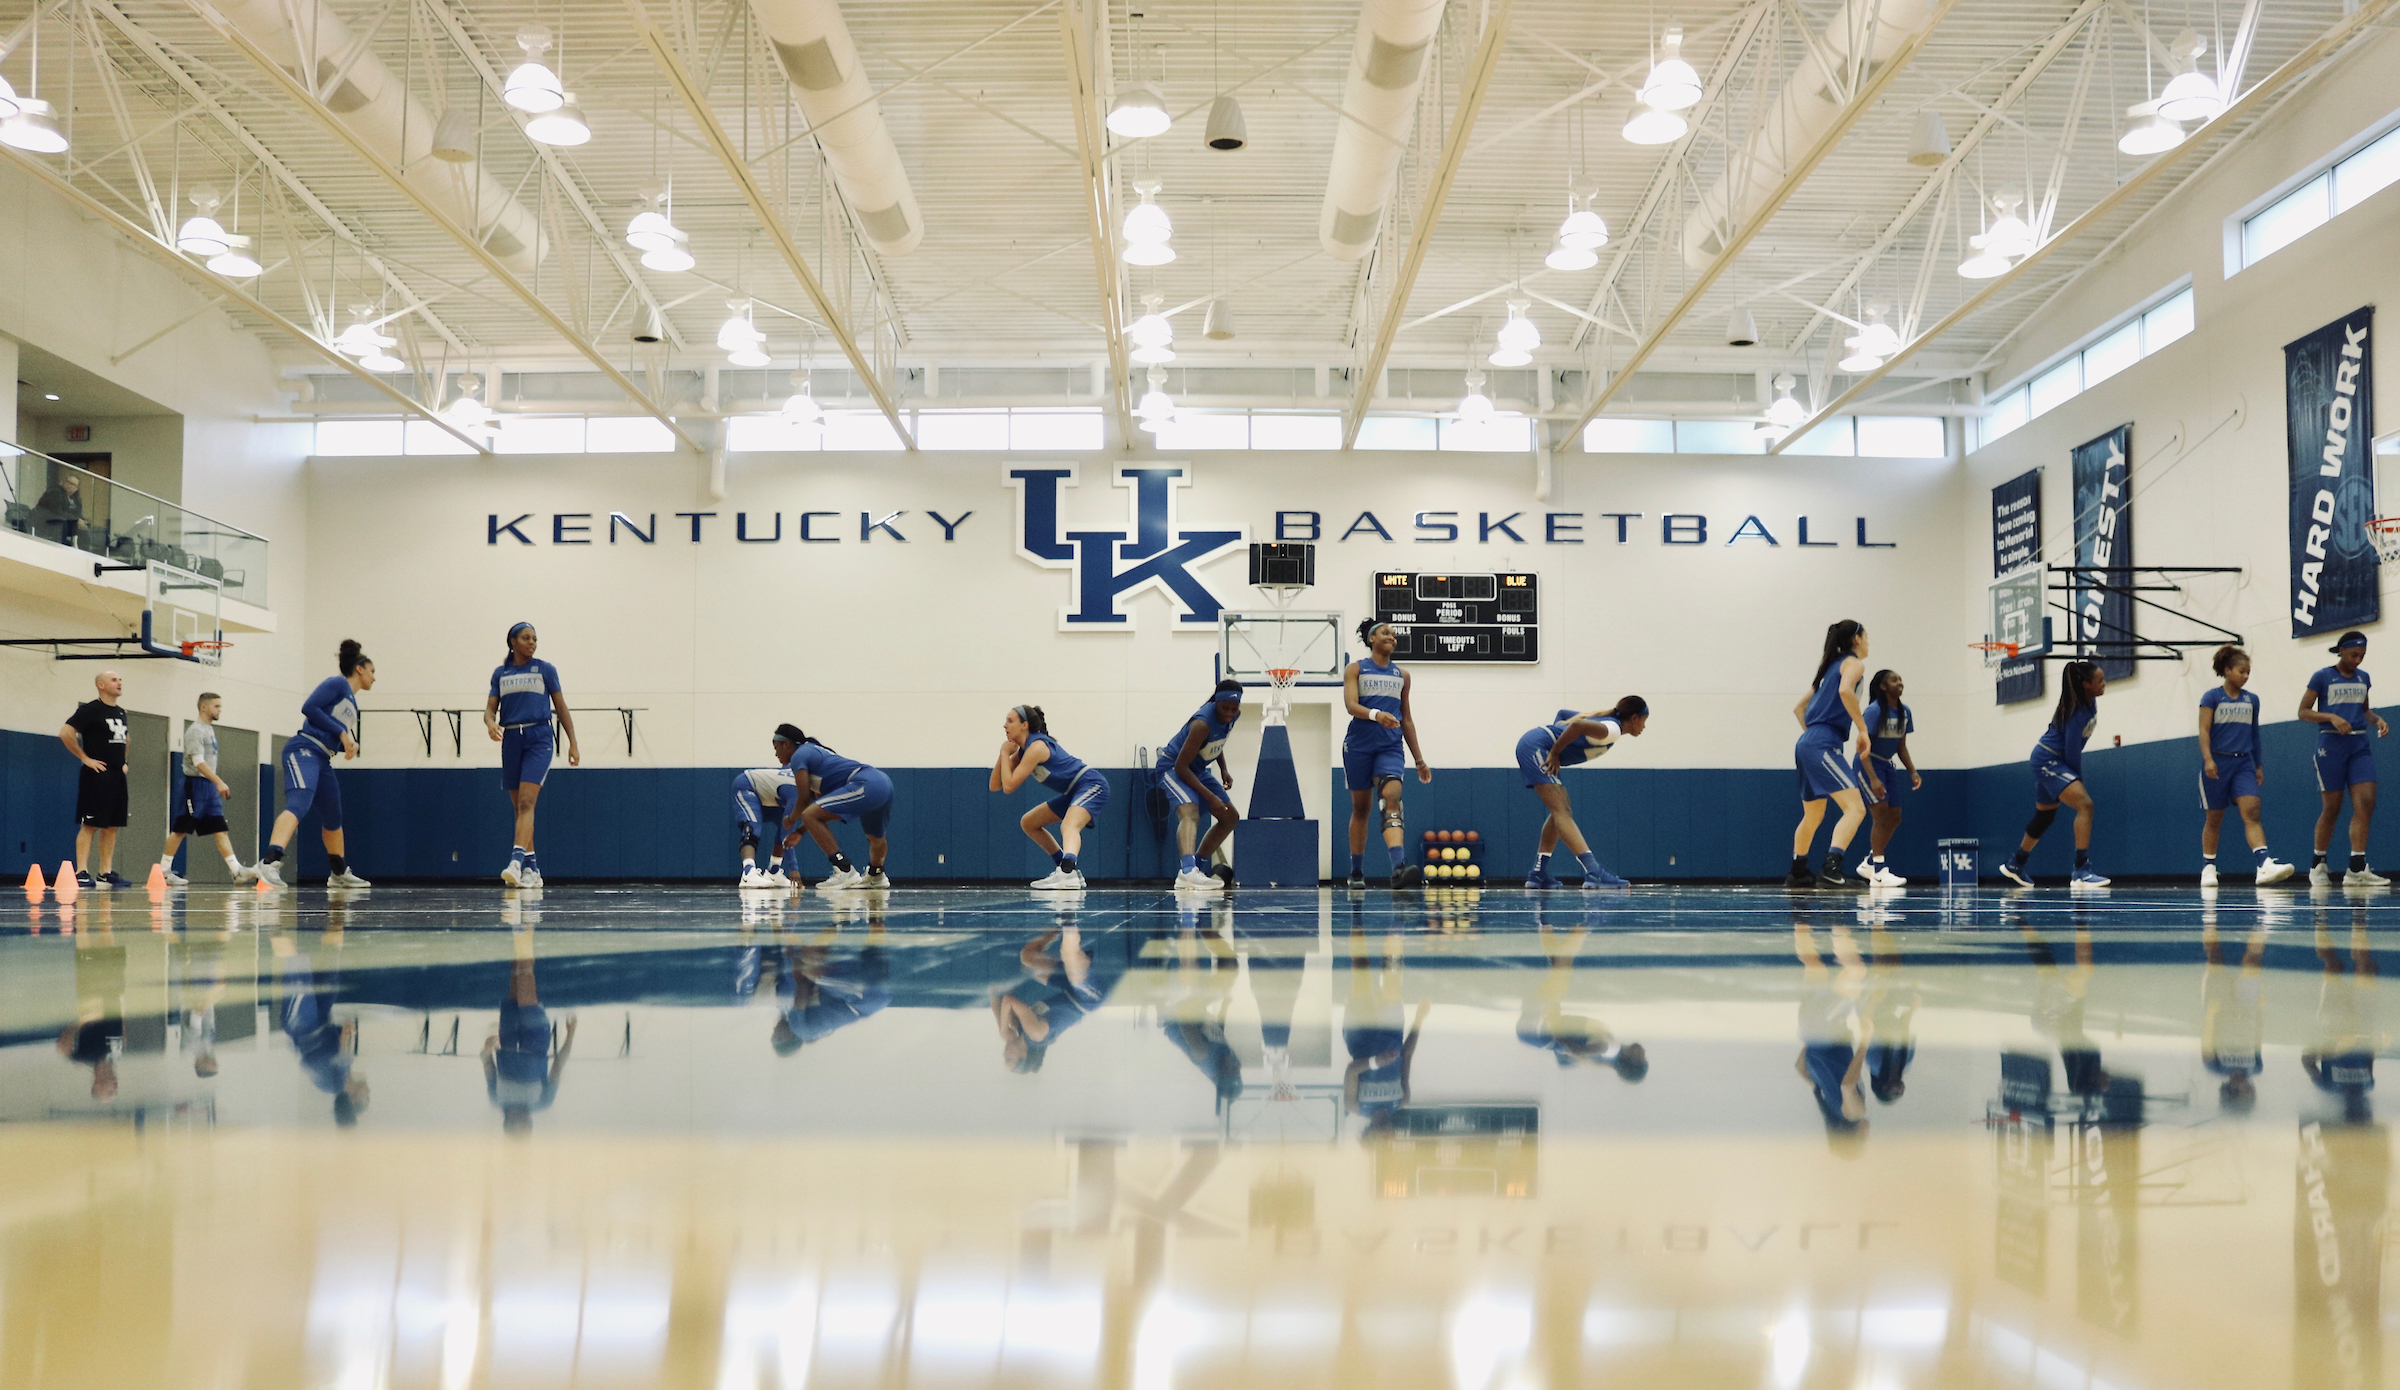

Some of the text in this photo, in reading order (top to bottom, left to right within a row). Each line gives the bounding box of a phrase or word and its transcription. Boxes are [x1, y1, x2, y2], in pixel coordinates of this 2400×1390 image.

[2293, 323, 2368, 628] HARD WORK
[1997, 504, 2010, 519] The
[2012, 509, 2036, 529] coming
[487, 510, 1898, 548] KENTUCKY BASKETBALL
[1004, 464, 1248, 630] UK
[1997, 539, 2005, 551] to
[2000, 553, 2008, 566] is
[1383, 574, 1408, 586] WHITE
[1505, 575, 1527, 587] BLUE
[1392, 613, 1417, 622] BONUS
[1435, 608, 1463, 617] PERIOD
[1496, 614, 1522, 622] BONUS
[1393, 626, 1411, 635] OULS
[1502, 627, 1525, 635] FOULS
[1439, 635, 1475, 644] TIMEOUTS
[1447, 643, 1465, 652] LEFT
[1363, 679, 1401, 688] KENTUCKY
